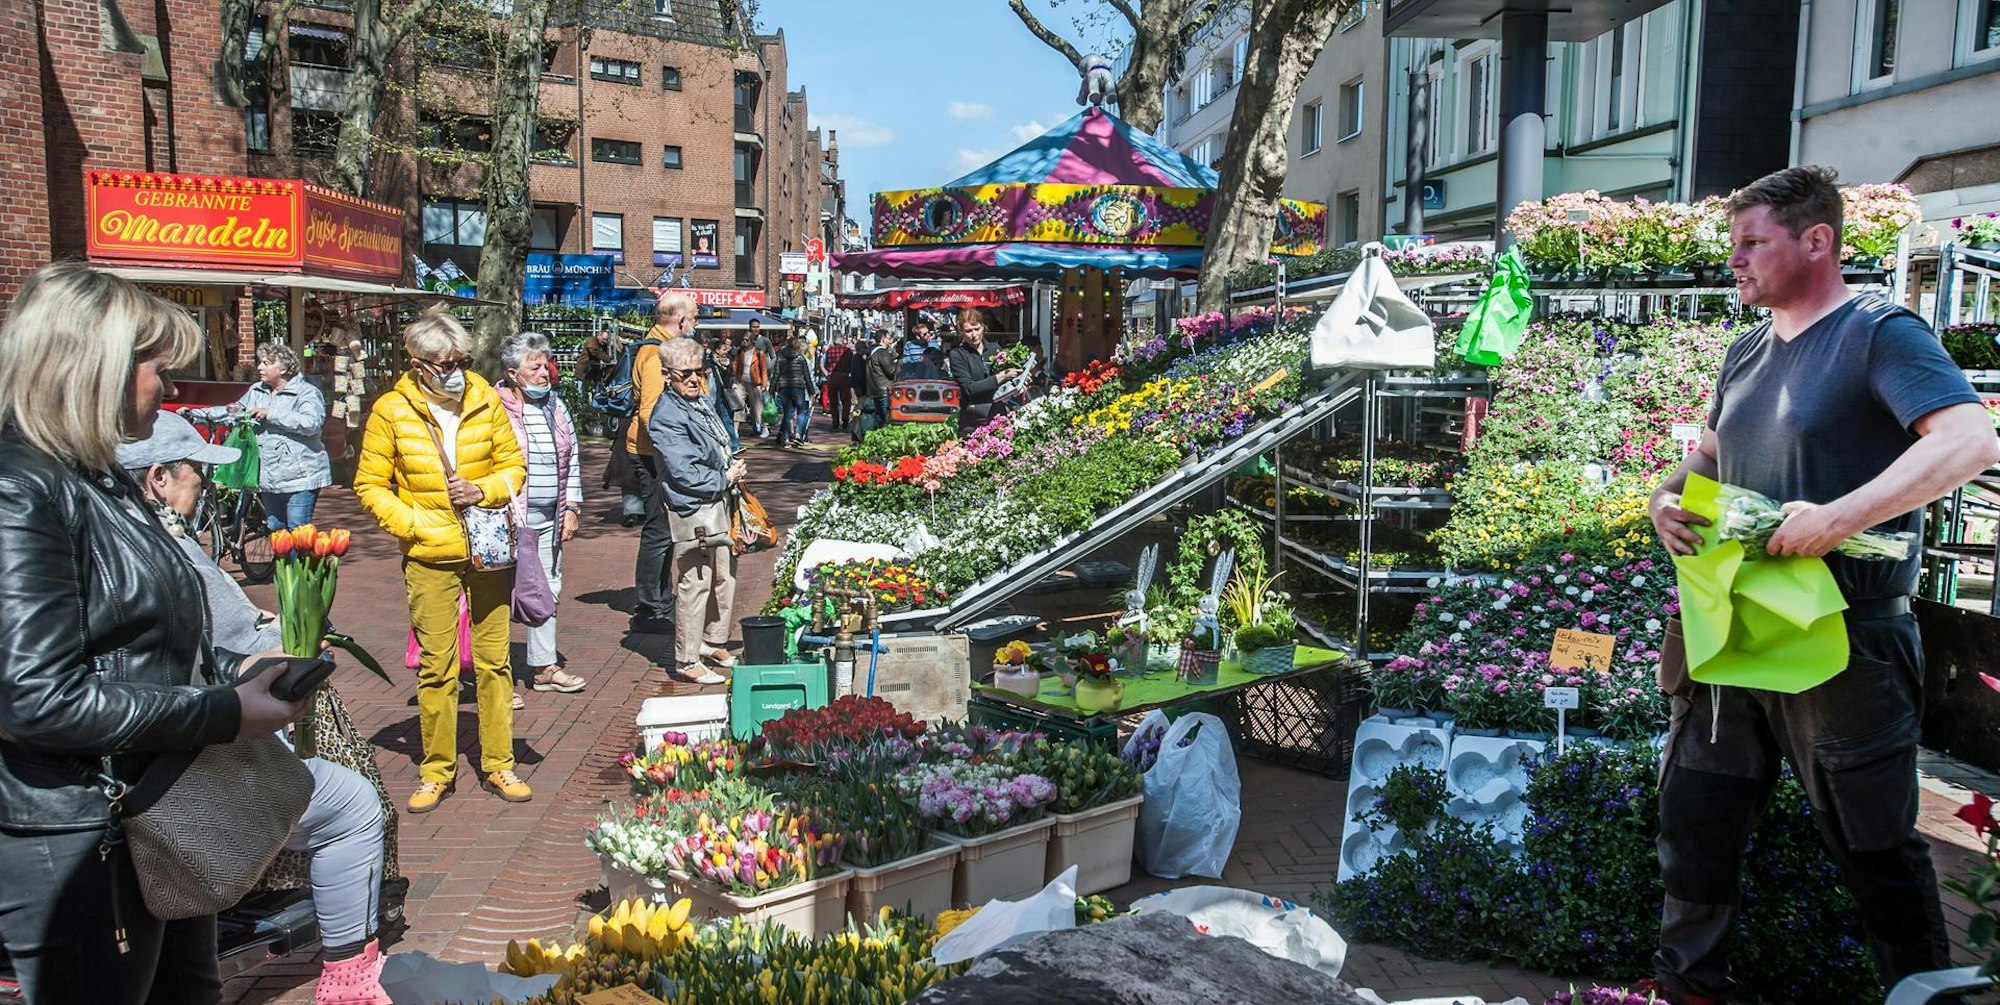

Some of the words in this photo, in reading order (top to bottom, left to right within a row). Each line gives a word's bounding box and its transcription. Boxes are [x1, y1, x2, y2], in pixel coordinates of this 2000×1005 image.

[134, 190, 253, 211] GEBRANNTE
[99, 209, 290, 250] Mandeln
[306, 207, 337, 248] Süße
[338, 215, 400, 254] Spezialitäten
[564, 264, 612, 275] MÜNCHEN
[700, 291, 733, 306] TREFF
